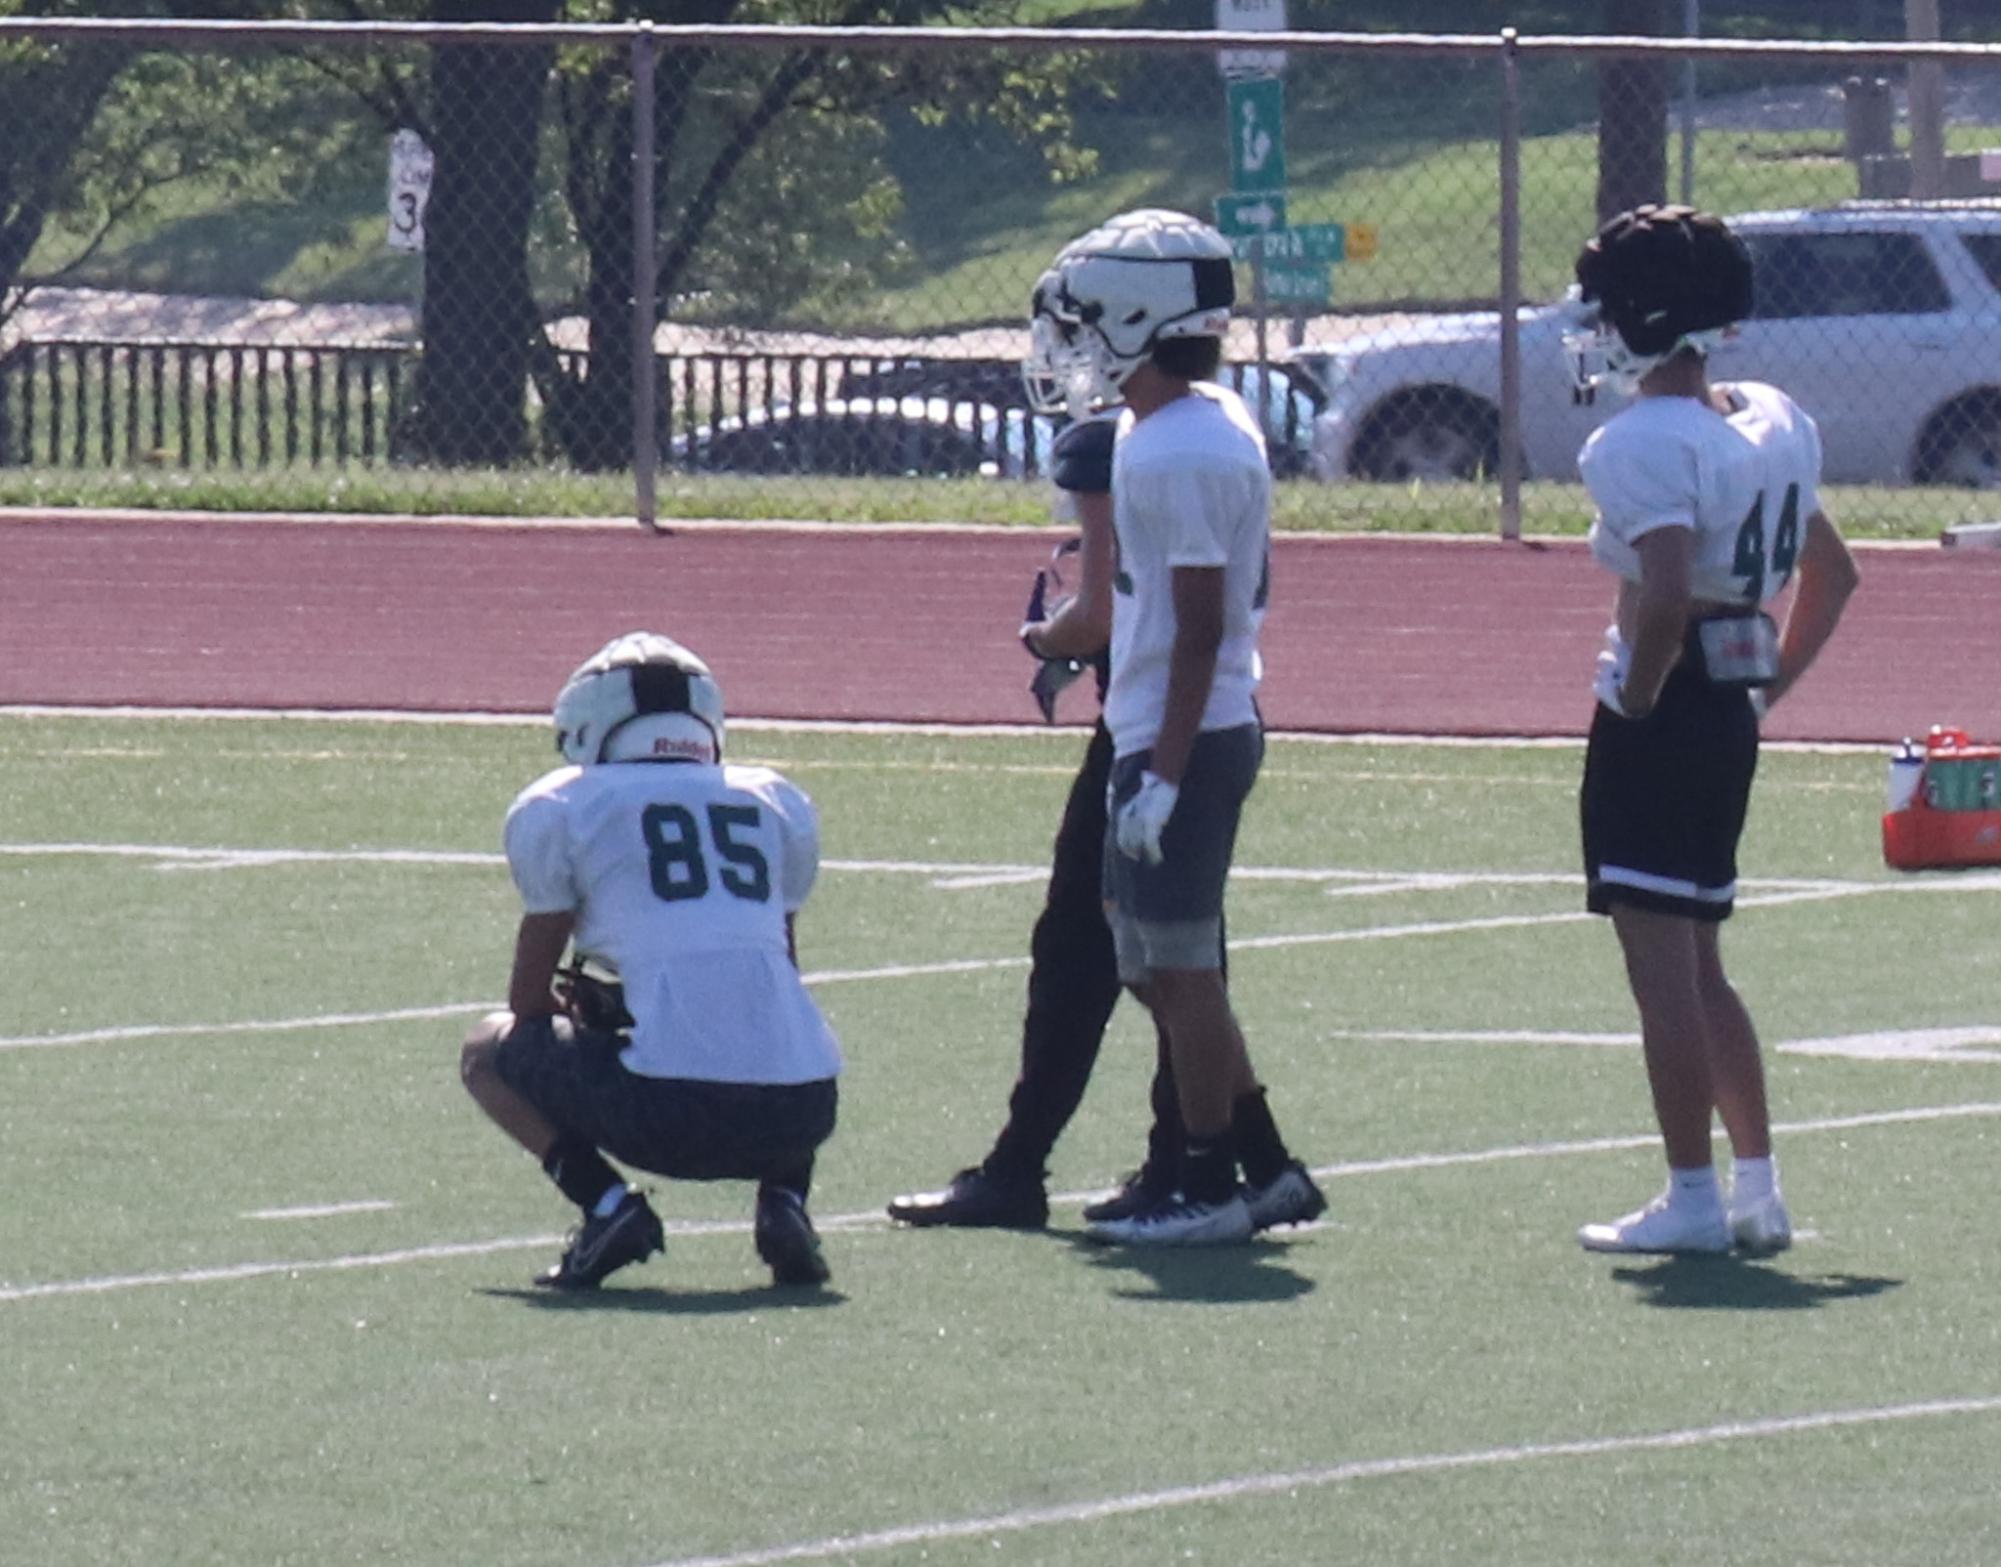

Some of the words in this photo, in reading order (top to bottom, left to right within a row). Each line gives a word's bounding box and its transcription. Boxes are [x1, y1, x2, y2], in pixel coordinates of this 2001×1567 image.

[395, 193, 417, 232] 3
[1731, 483, 1799, 605] 44
[641, 803, 770, 904] 85
